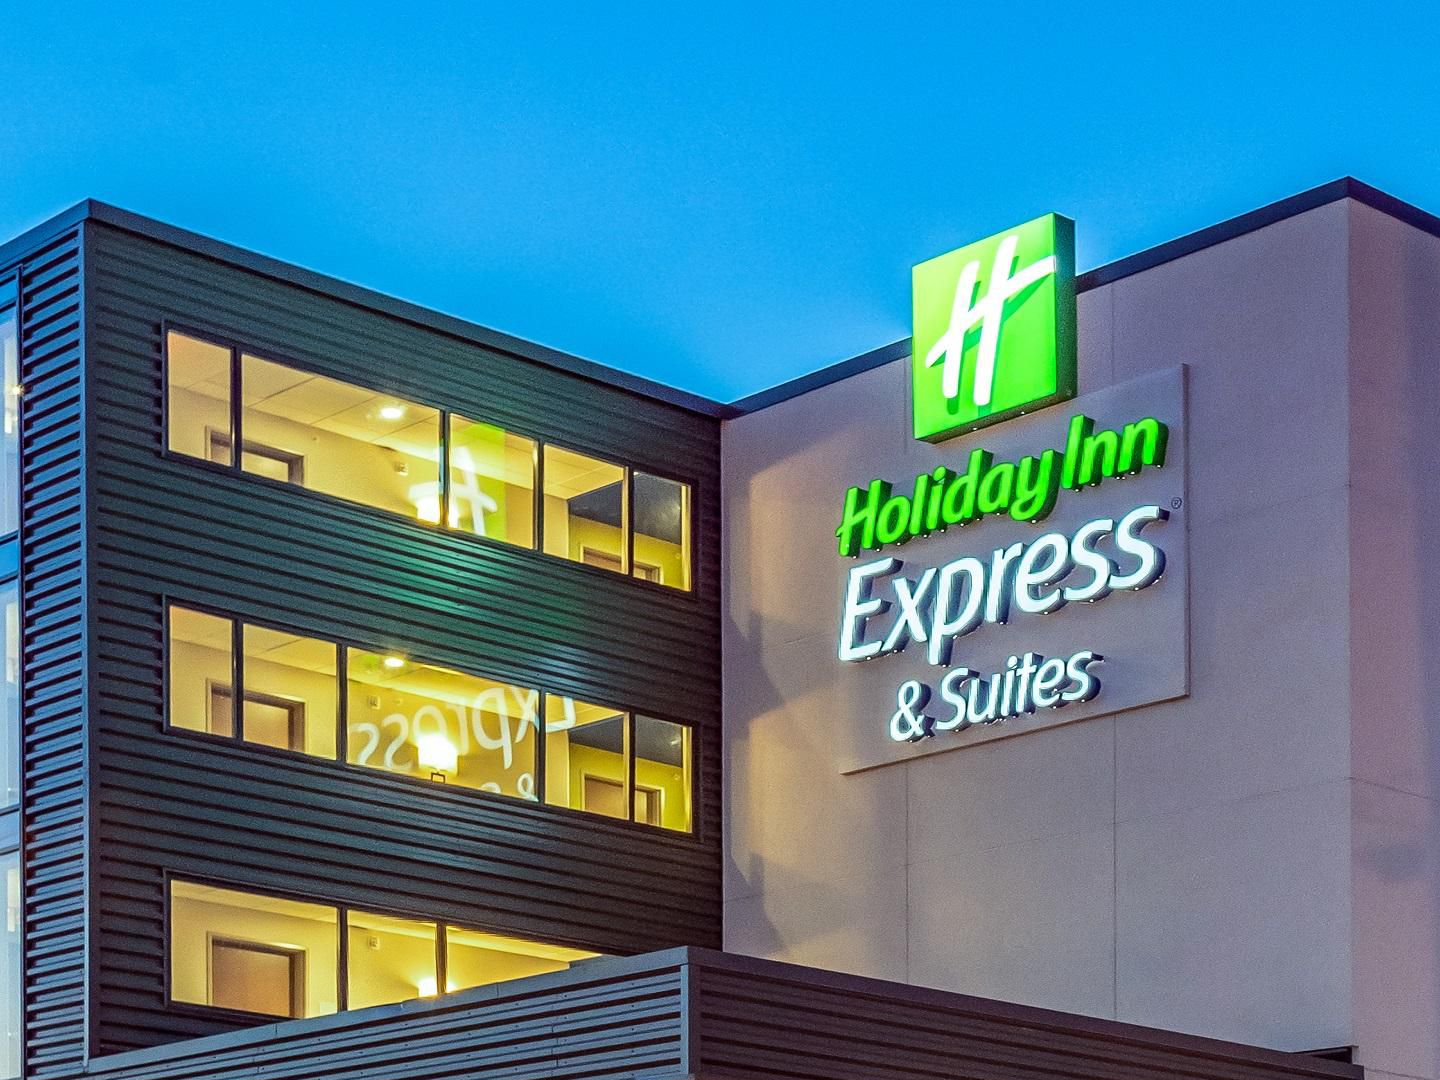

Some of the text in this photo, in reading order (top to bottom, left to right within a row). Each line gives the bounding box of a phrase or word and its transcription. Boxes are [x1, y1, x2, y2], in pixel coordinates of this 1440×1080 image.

[835, 414, 1163, 557] Holiday Inn
[838, 505, 1164, 666] Express
[889, 651, 1096, 742] & Suites
